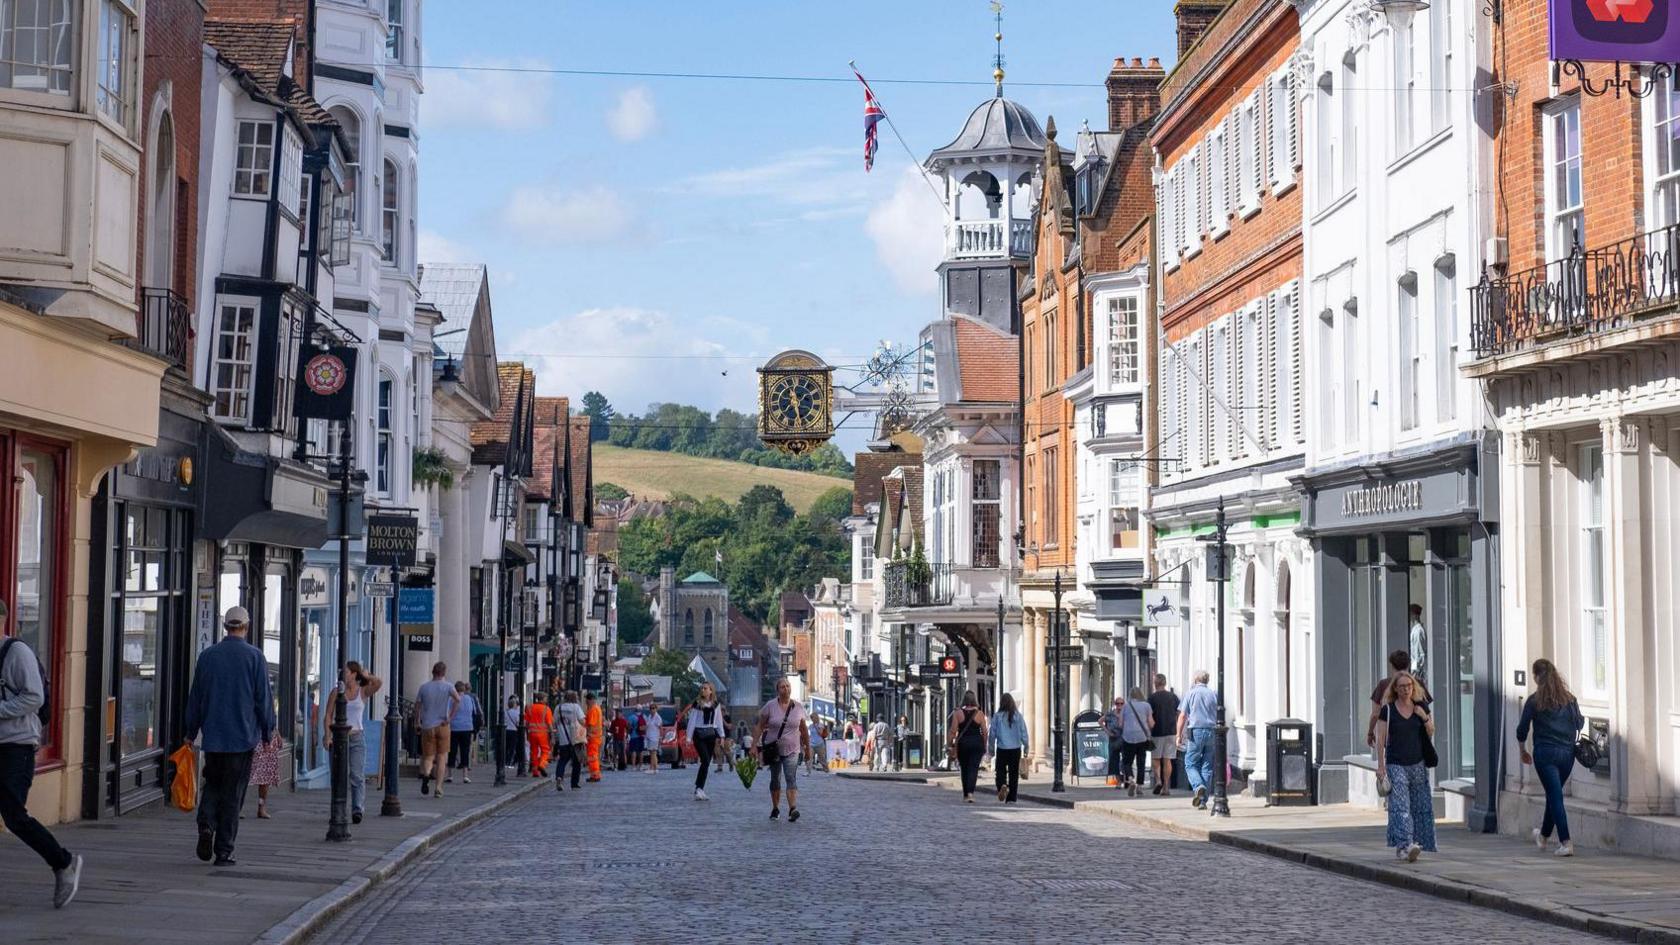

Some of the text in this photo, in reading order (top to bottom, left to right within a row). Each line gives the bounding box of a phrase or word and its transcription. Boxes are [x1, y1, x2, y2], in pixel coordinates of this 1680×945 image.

[1341, 480, 1419, 515] ANTHROPOLOGIE
[370, 525, 416, 538] MOLTON
[370, 538, 415, 550] BROWN
[411, 635, 431, 643] BOSS
